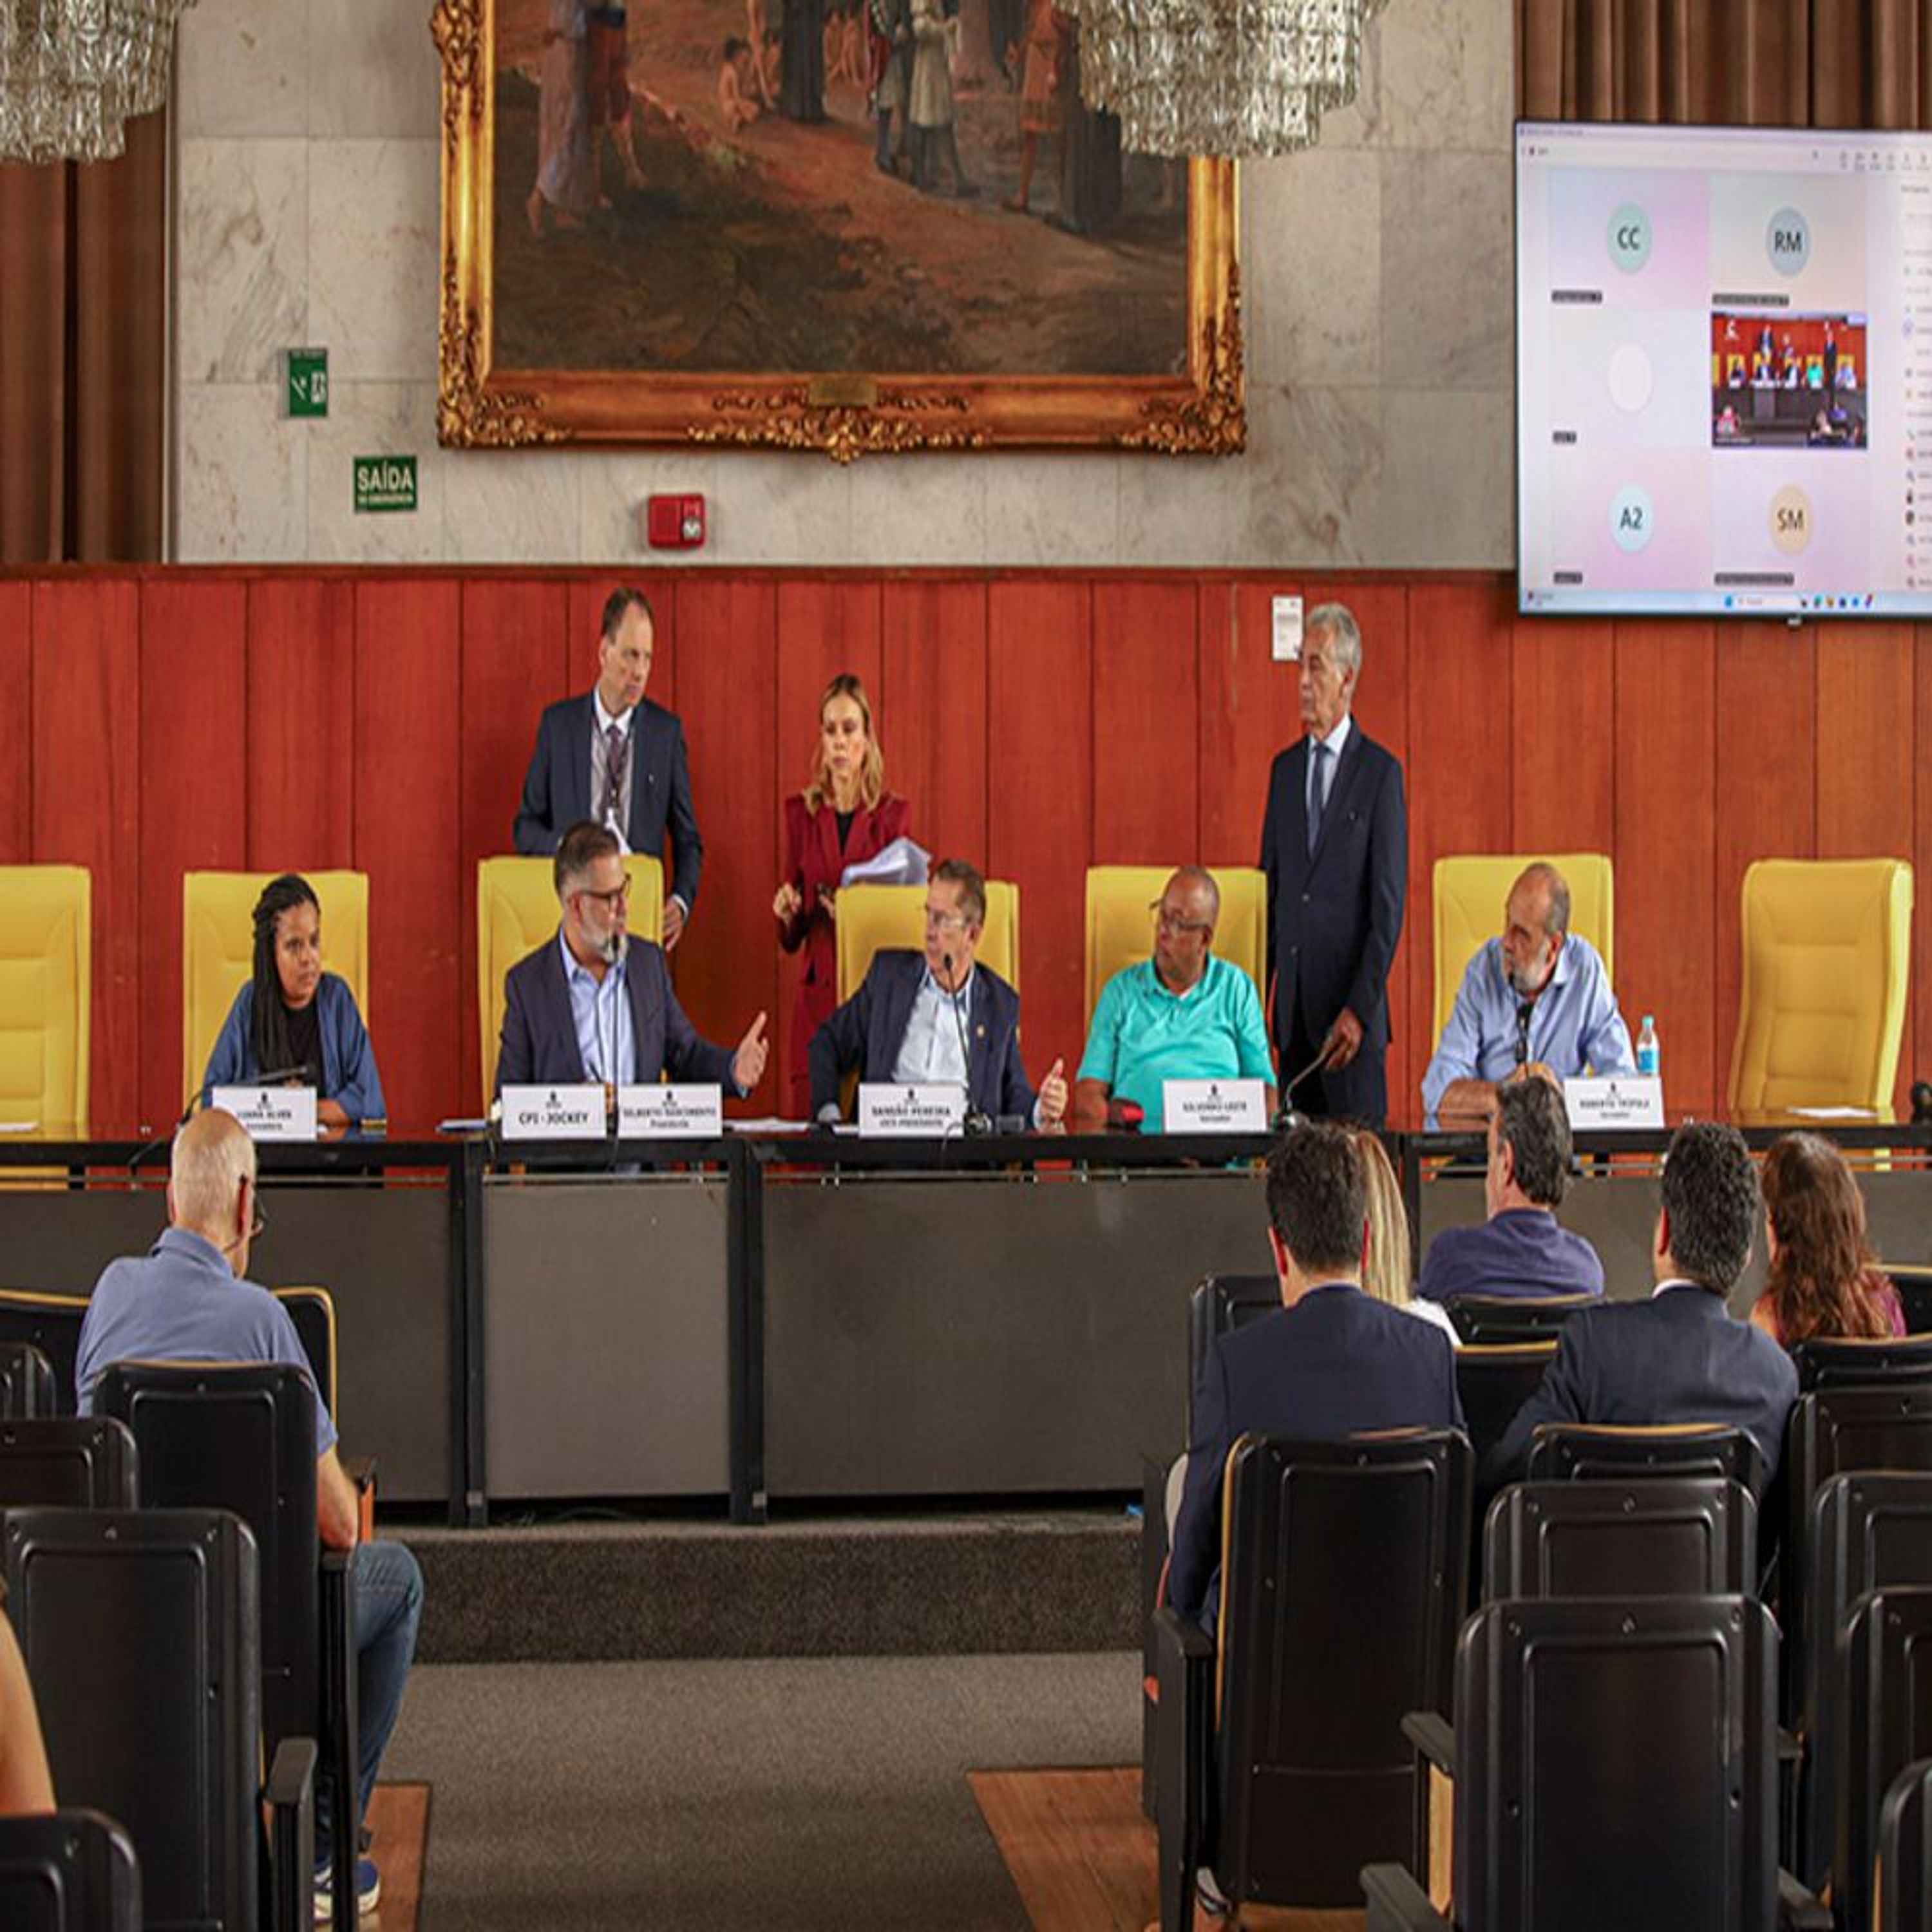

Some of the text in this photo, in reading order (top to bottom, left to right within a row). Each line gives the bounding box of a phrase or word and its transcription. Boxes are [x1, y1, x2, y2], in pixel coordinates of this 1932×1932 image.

[1617, 227, 1640, 250] CC
[1775, 231, 1801, 253] RM
[358, 460, 414, 490] SAÍDA
[1620, 507, 1643, 530] A2
[1777, 509, 1803, 531] SM
[518, 1112, 539, 1125] CPI
[547, 1112, 588, 1125] JOCKEY
